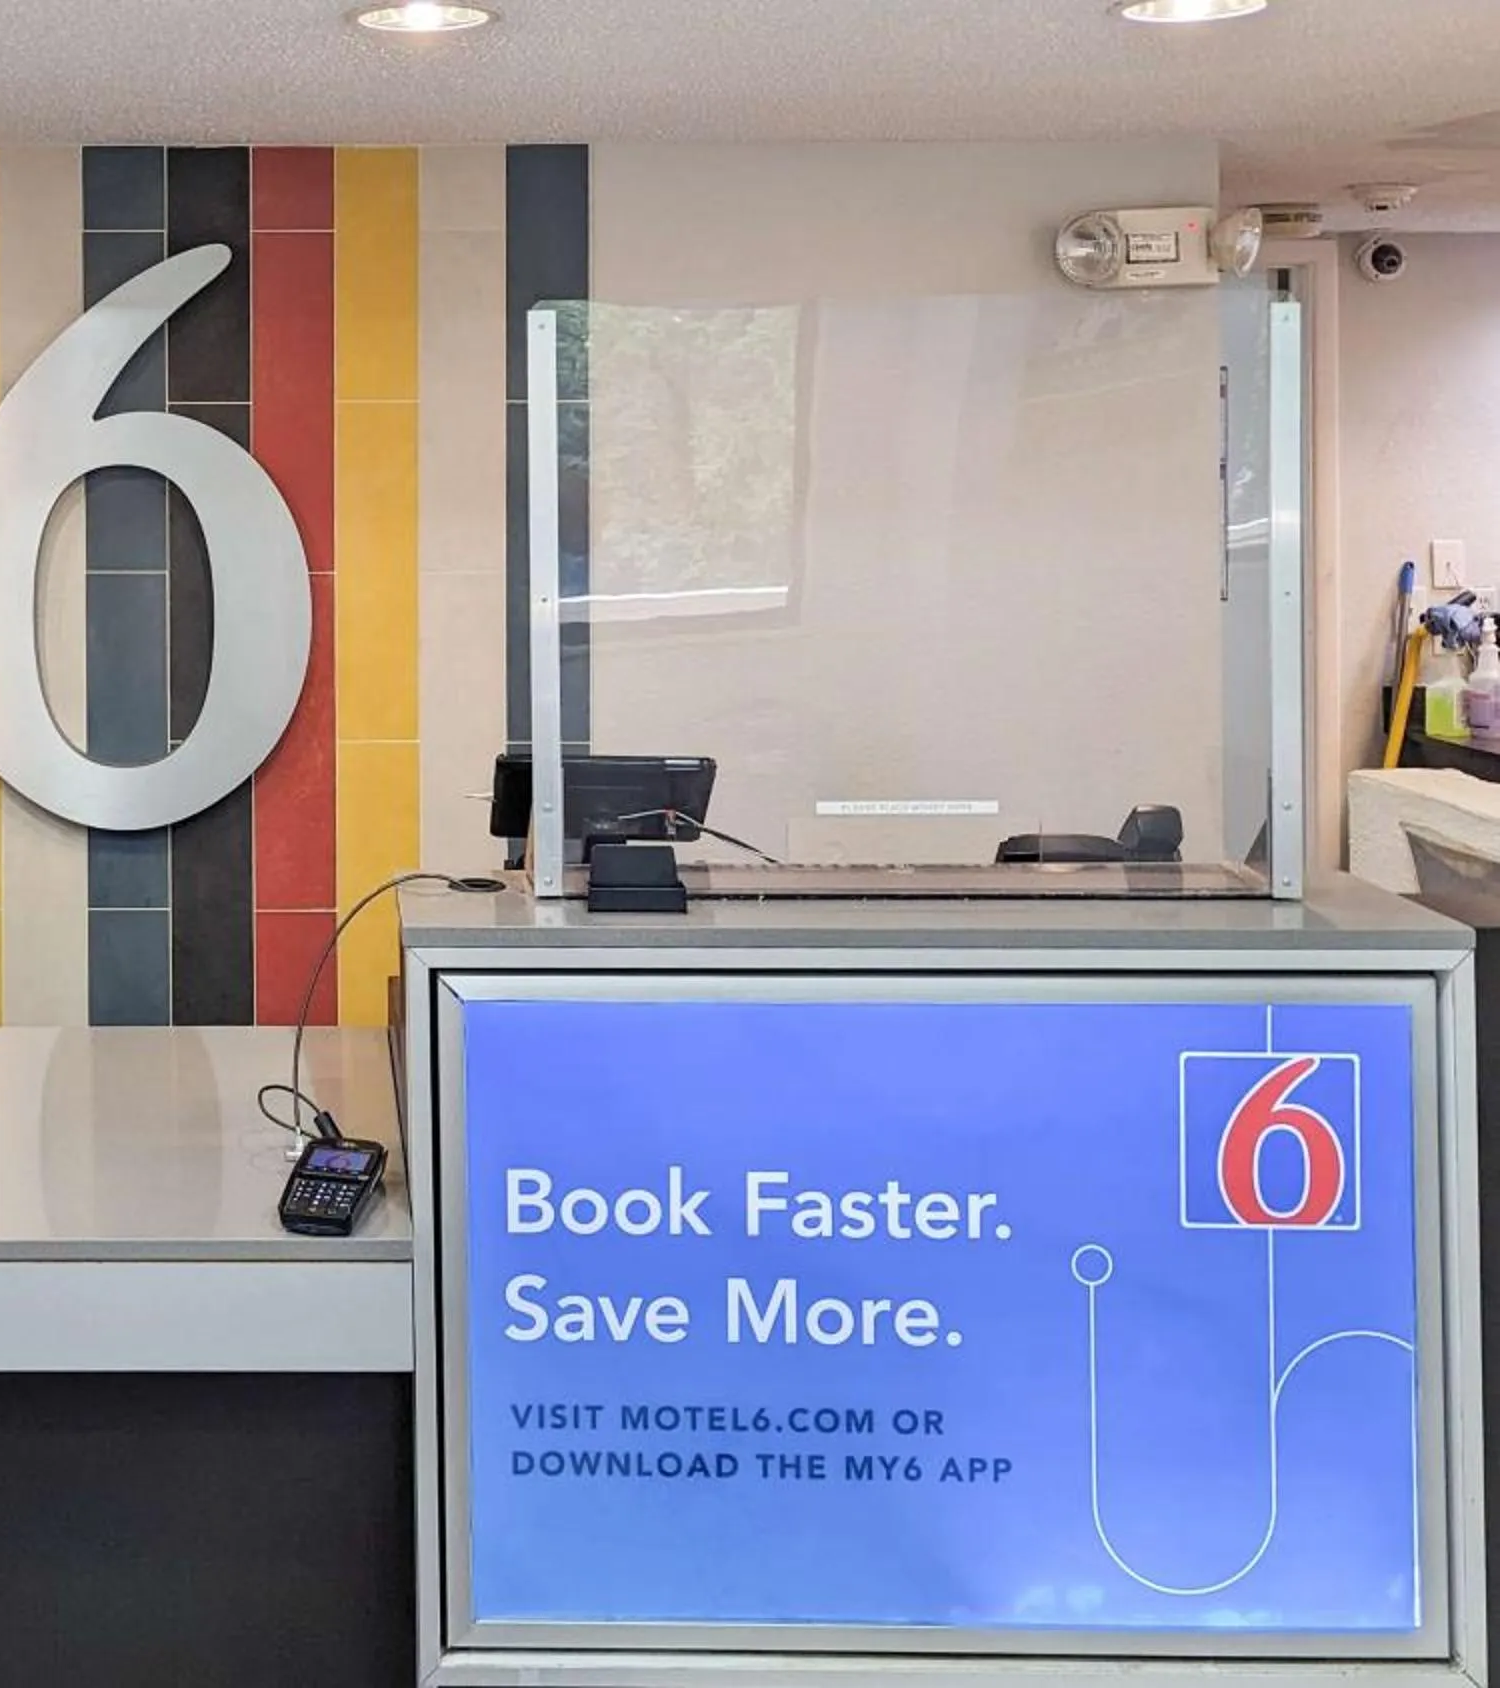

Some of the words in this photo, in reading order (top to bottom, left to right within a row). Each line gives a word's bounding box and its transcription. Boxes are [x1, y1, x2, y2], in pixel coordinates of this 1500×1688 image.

[1217, 1055, 1345, 1228] 6
[506, 1166, 713, 1236] Book
[745, 1170, 1012, 1240] Faster.
[504, 1274, 690, 1343] Save
[726, 1277, 962, 1347] More.
[510, 1404, 604, 1430] VISIT
[621, 1405, 875, 1434] MOTEL6.COM
[892, 1409, 945, 1435] OR
[511, 1450, 739, 1479] DOWNLOAD
[756, 1454, 826, 1480] THE
[845, 1455, 924, 1482] MY6
[939, 1457, 1013, 1483] APP
